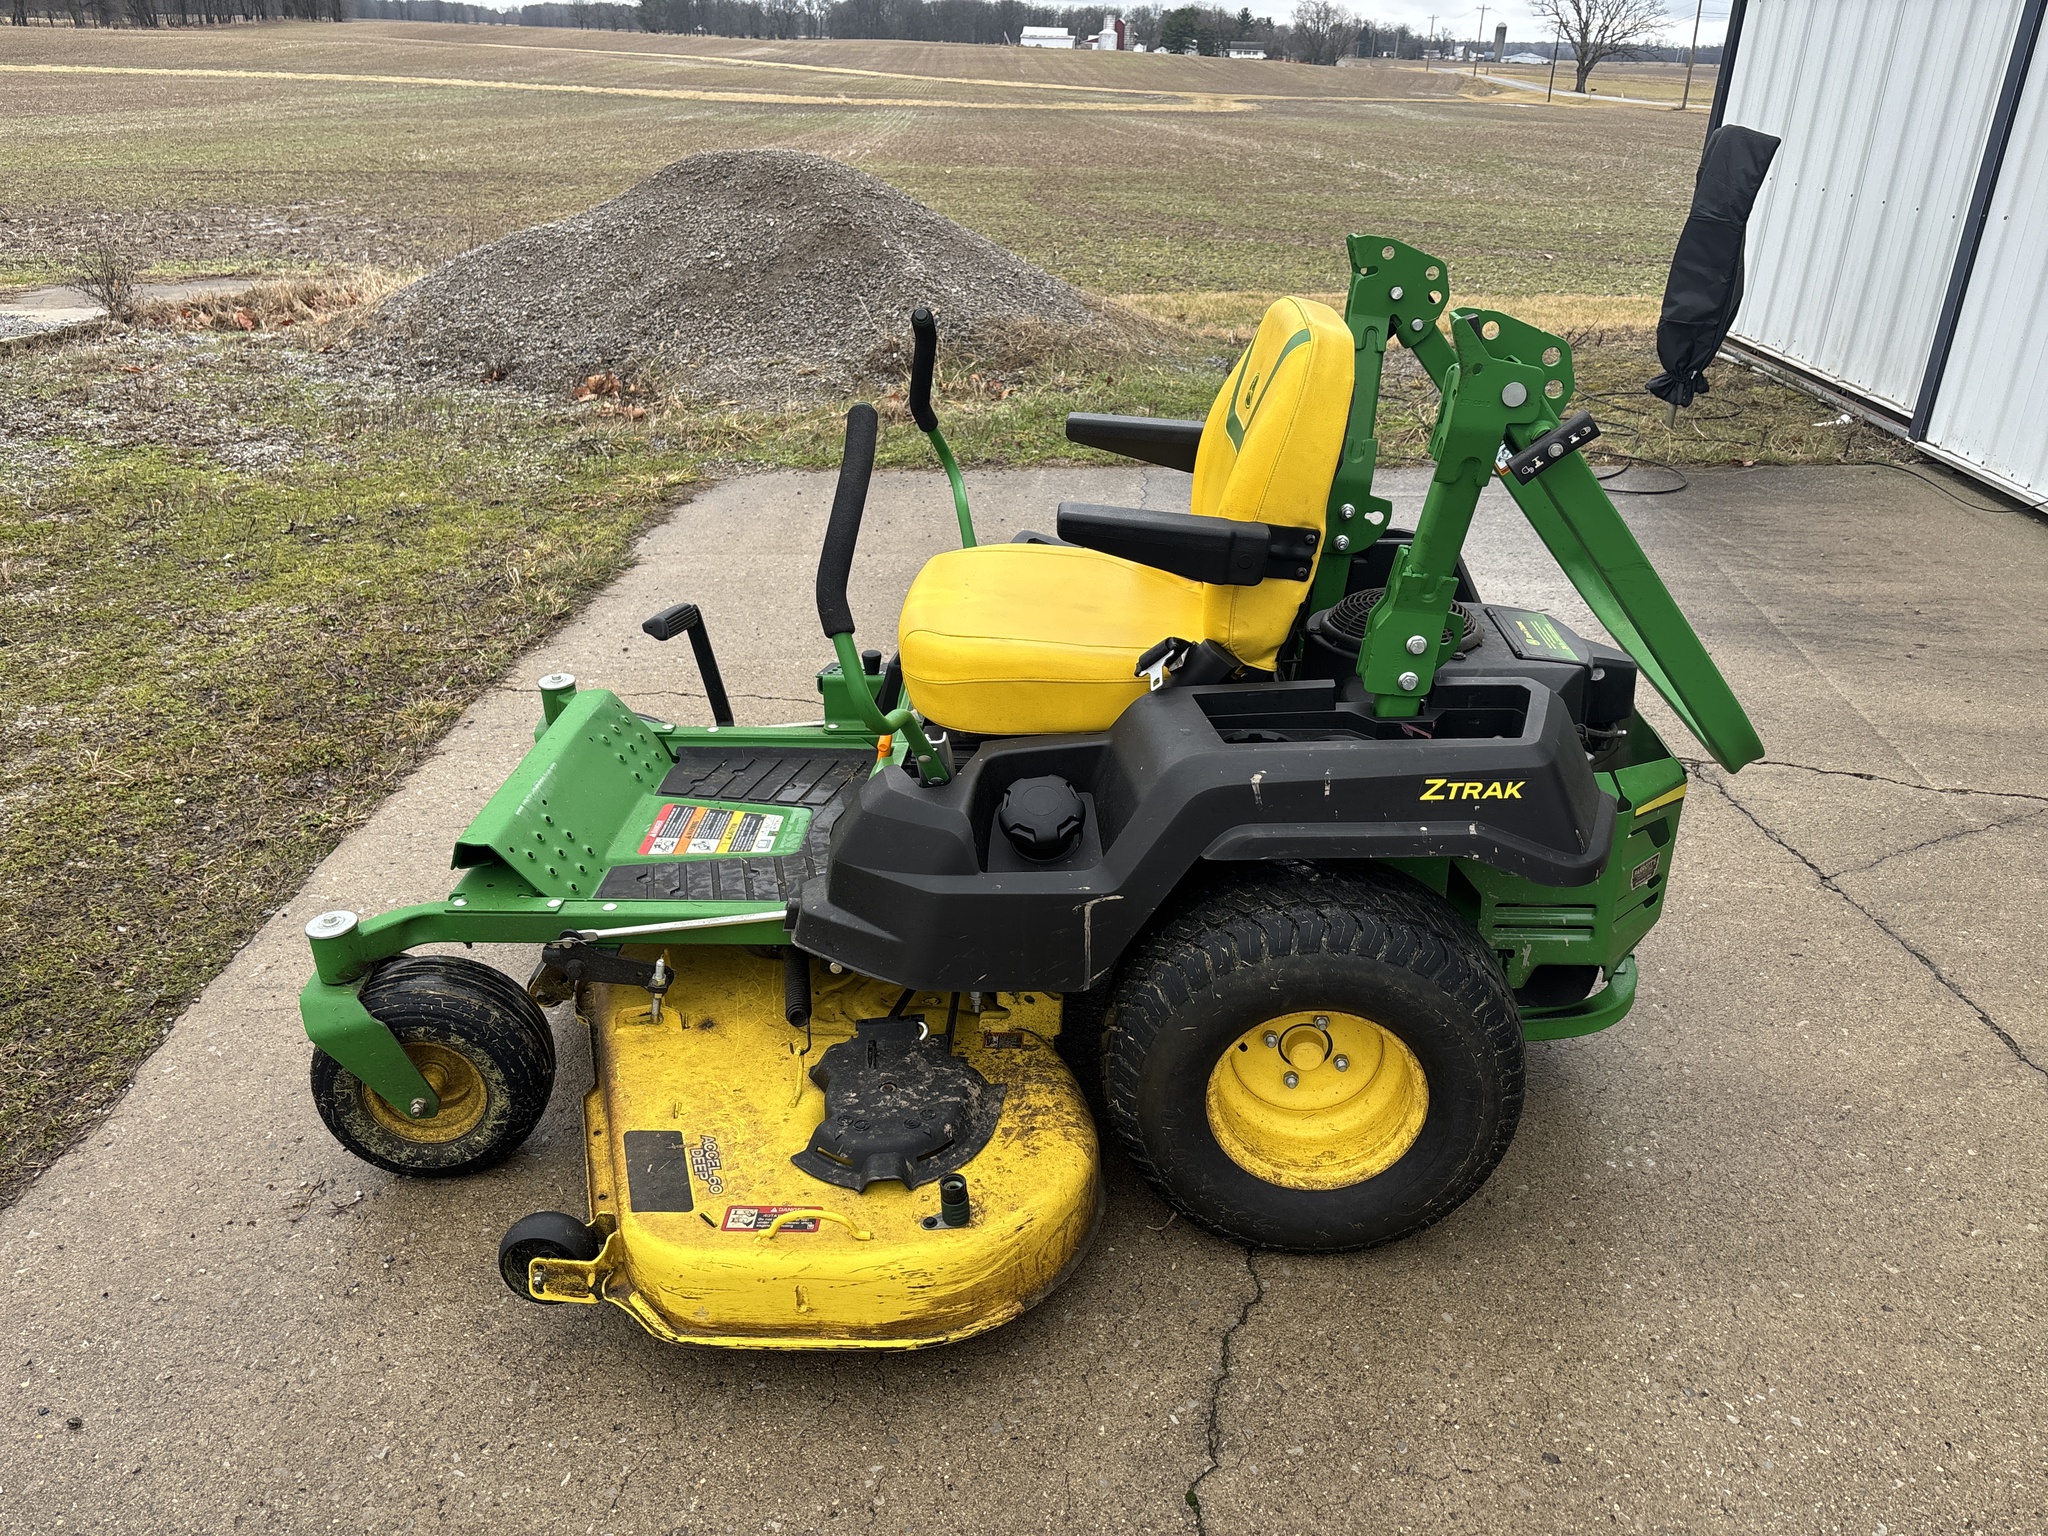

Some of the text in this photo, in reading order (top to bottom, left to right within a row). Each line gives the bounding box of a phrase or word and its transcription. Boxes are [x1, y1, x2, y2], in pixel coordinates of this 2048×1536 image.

[1419, 778, 1526, 801] ZTRAK
[690, 1148, 709, 1180] DEEP
[701, 1135, 724, 1194] ACCEL 60
